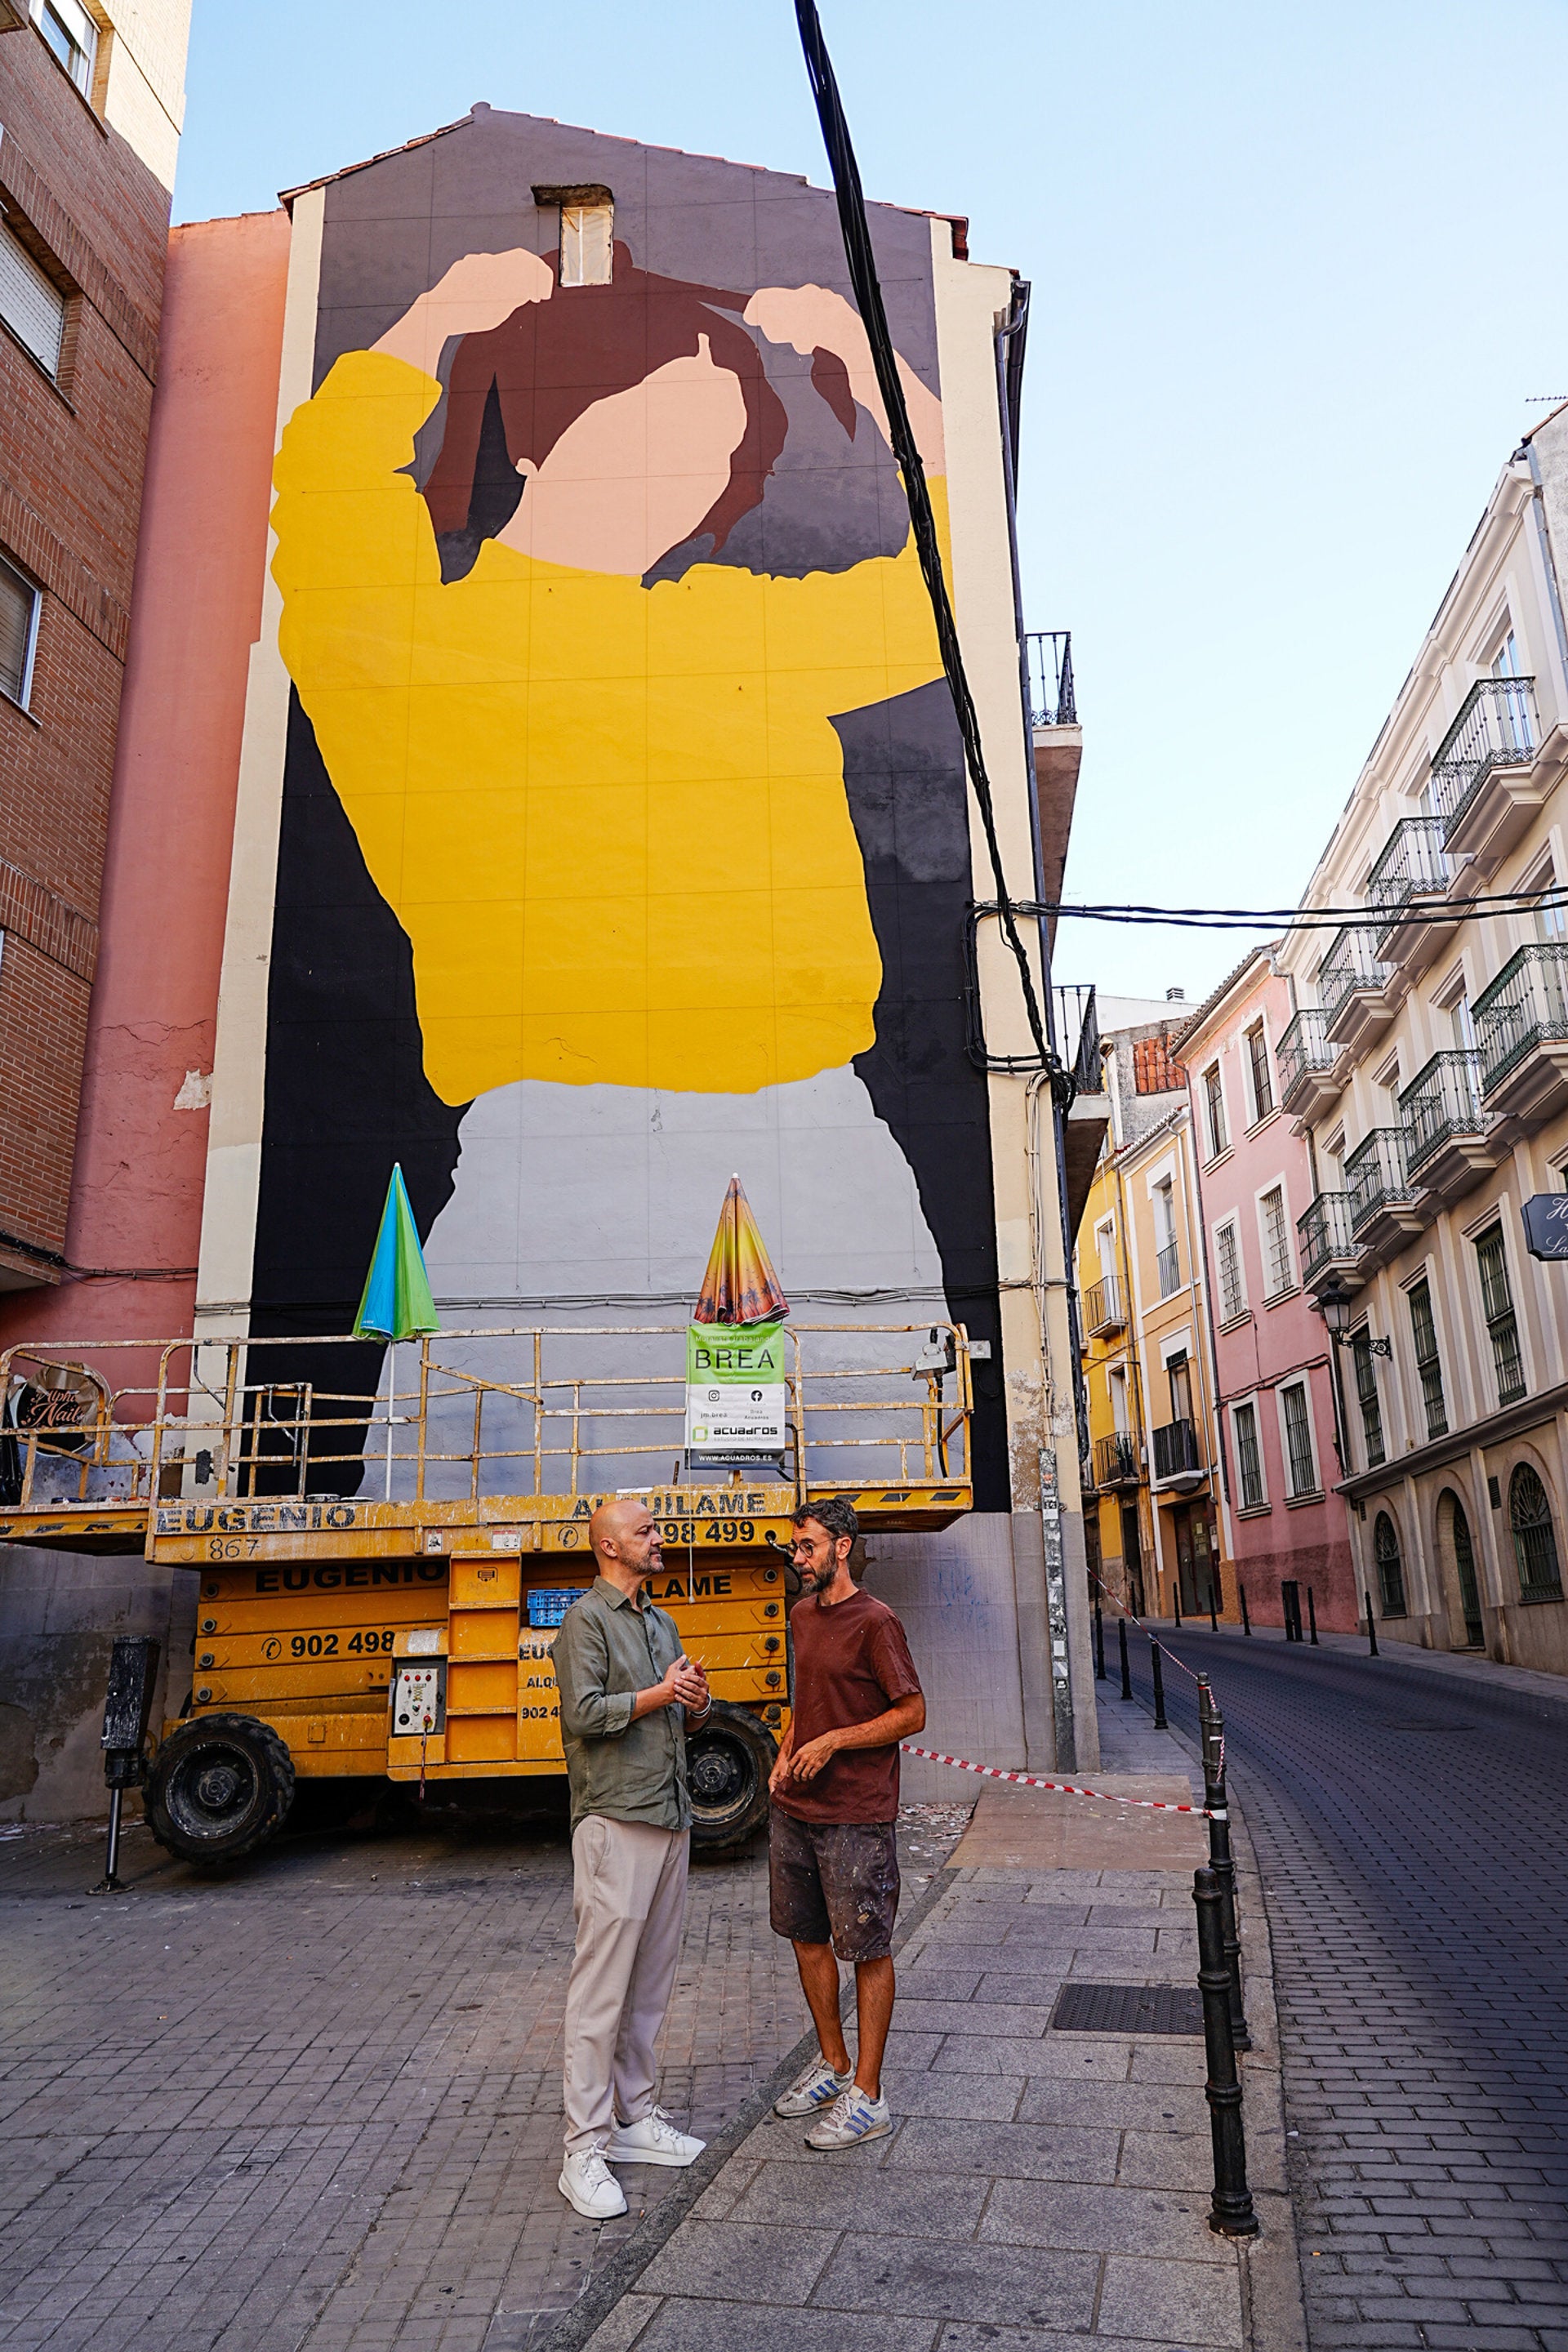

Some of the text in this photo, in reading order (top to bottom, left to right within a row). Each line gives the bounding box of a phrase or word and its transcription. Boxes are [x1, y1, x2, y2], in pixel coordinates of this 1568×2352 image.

[695, 1348, 775, 1369] BREA
[29, 1403, 85, 1428] Nail
[713, 1427, 778, 1435] acuadros
[156, 1505, 356, 1533] EUGENIO
[705, 1520, 755, 1543] 499
[209, 1538, 261, 1561] 867
[255, 1561, 446, 1593] EUGENIO
[291, 1630, 396, 1658] 902 498
[522, 1706, 548, 1719] 902
